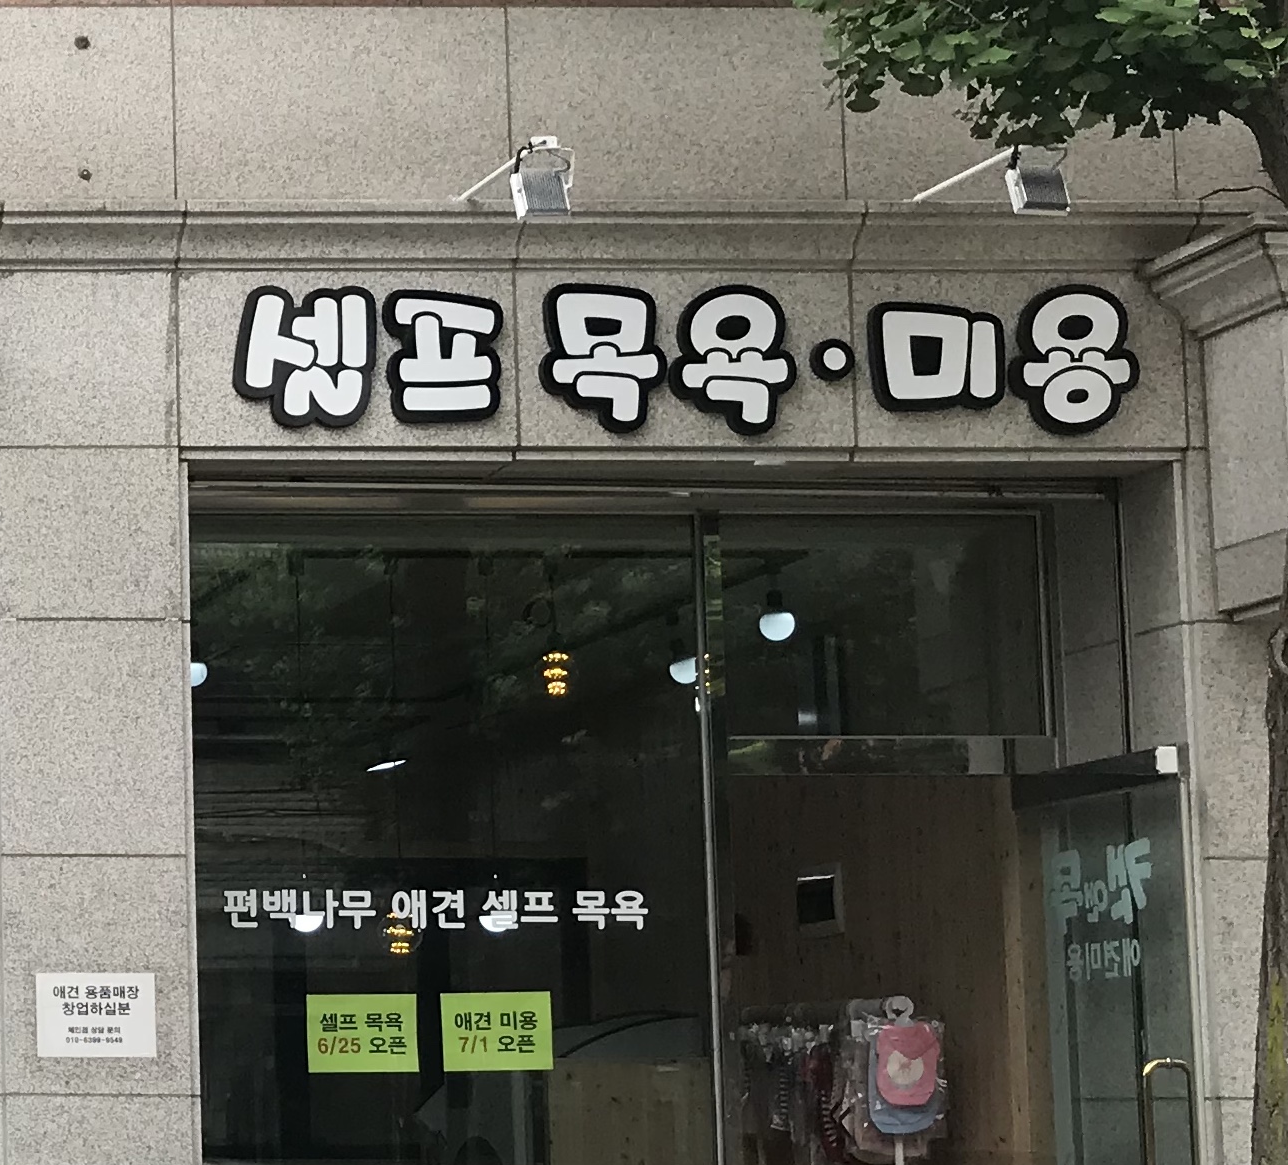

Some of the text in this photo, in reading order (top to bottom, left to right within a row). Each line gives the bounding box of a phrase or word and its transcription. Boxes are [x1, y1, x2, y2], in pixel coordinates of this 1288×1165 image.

[231, 285, 505, 428] 셀프
[223, 888, 649, 931] 편백나무 애견 셀프 목욕
[53, 985, 139, 999] 애견 용품매장
[62, 1002, 131, 1016] 창업하실분
[319, 1012, 404, 1032] 셀프 목욕
[454, 1011, 538, 1031] 애견 미용
[317, 1035, 408, 1055] 6/25 오픈
[458, 1034, 536, 1055] 7/1 오픈
